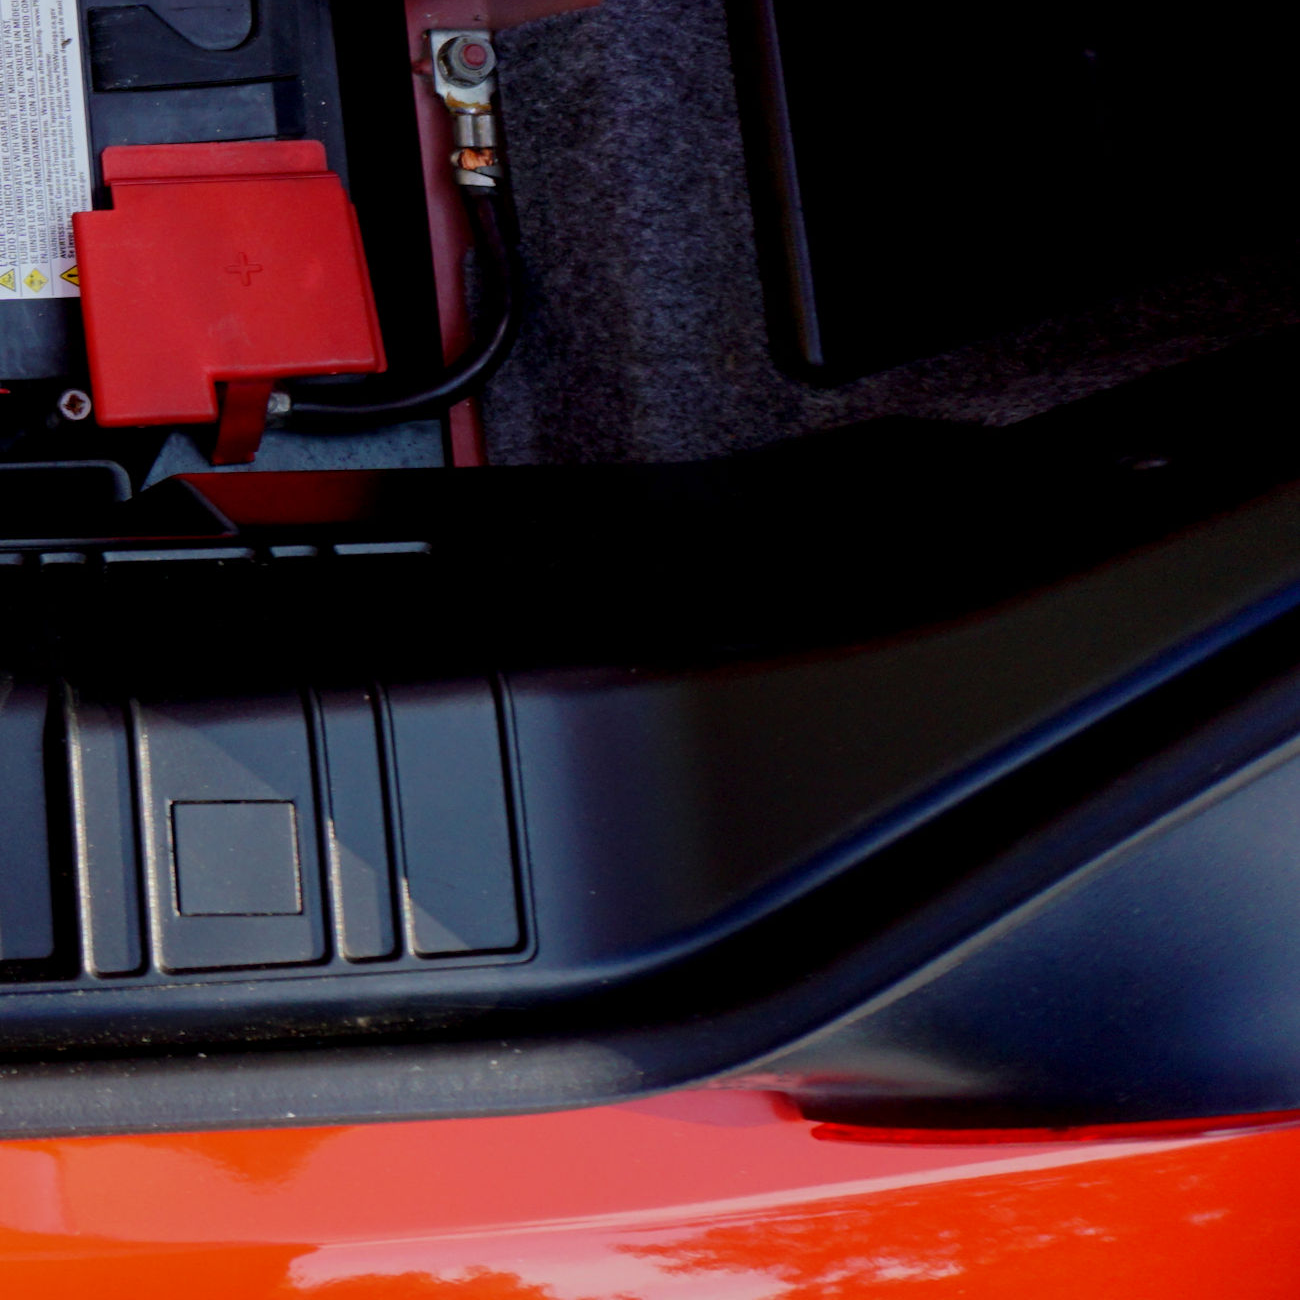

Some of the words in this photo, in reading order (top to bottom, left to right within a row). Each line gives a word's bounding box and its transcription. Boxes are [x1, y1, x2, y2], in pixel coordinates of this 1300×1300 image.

[14, 30, 22, 42] UN
[5, 39, 13, 58] HELP
[24, 45, 34, 71] ACUDA
[15, 43, 26, 87] CONSULTER
[6, 60, 16, 94] MEDICAL
[8, 96, 17, 110] GET
[28, 100, 37, 117] CON
[0, 120, 10, 153] CAUSAR
[12, 142, 21, 162] WITH
[30, 119, 43, 188] INMEDIATAMENTE
[2, 155, 12, 182] PUEDE
[13, 164, 25, 216] IMMEDIATELY
[25, 187, 34, 208] YEUX
[35, 189, 44, 210] OJOS
[26, 209, 36, 223] LES
[37, 211, 46, 226] LOS
[17, 217, 26, 237] EYES
[28, 224, 38, 253] RINSER
[38, 226, 48, 264] ENJUAGE
[19, 240, 28, 265] FLUSH
[30, 255, 39, 264] SE
